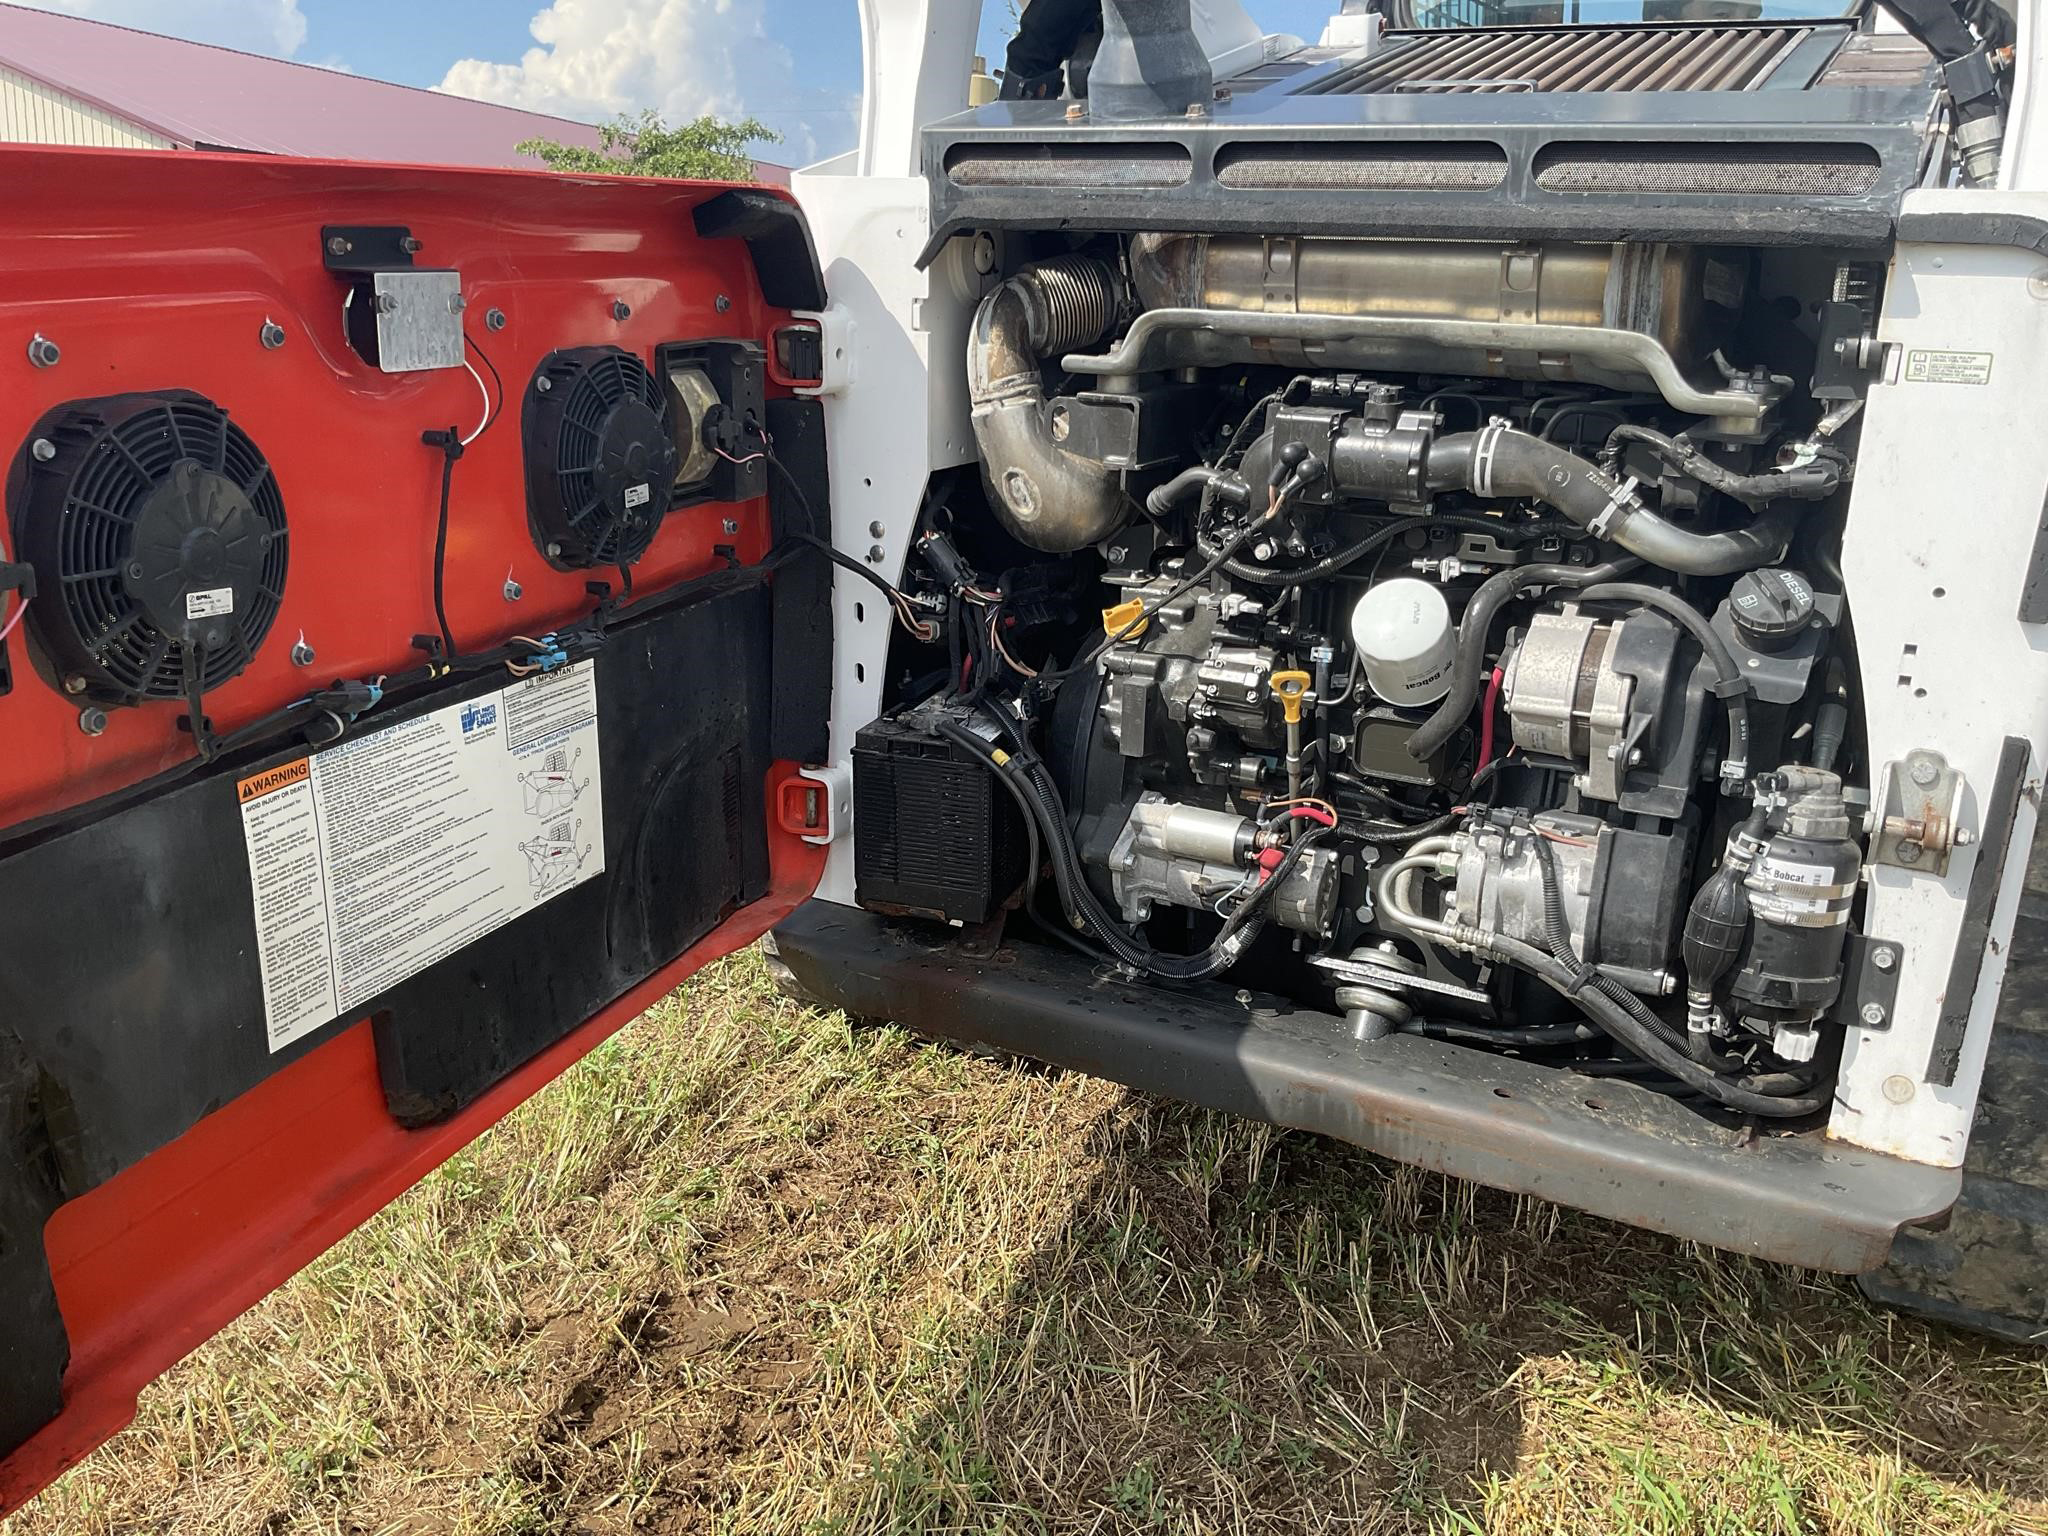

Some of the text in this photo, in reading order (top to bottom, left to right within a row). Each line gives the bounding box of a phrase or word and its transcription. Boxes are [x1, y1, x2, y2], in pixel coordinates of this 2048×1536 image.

[1780, 572, 1810, 606] DIESEL
[536, 666, 575, 684] IMPORTANT
[1406, 672, 1440, 690] Bobcat
[477, 714, 496, 728] SMART
[316, 746, 344, 761] SERVICE
[346, 731, 382, 750] CHECKLIST
[384, 726, 397, 736] AND
[398, 715, 430, 733] SCHEDULE
[512, 719, 594, 756] GENERAL LUBRICATION DIAGRAMS
[253, 763, 306, 792] WARNING
[246, 802, 260, 812] AVOID
[262, 795, 280, 805] INJURY
[290, 784, 306, 794] DEATH
[1774, 870, 1804, 883] Bobcat
